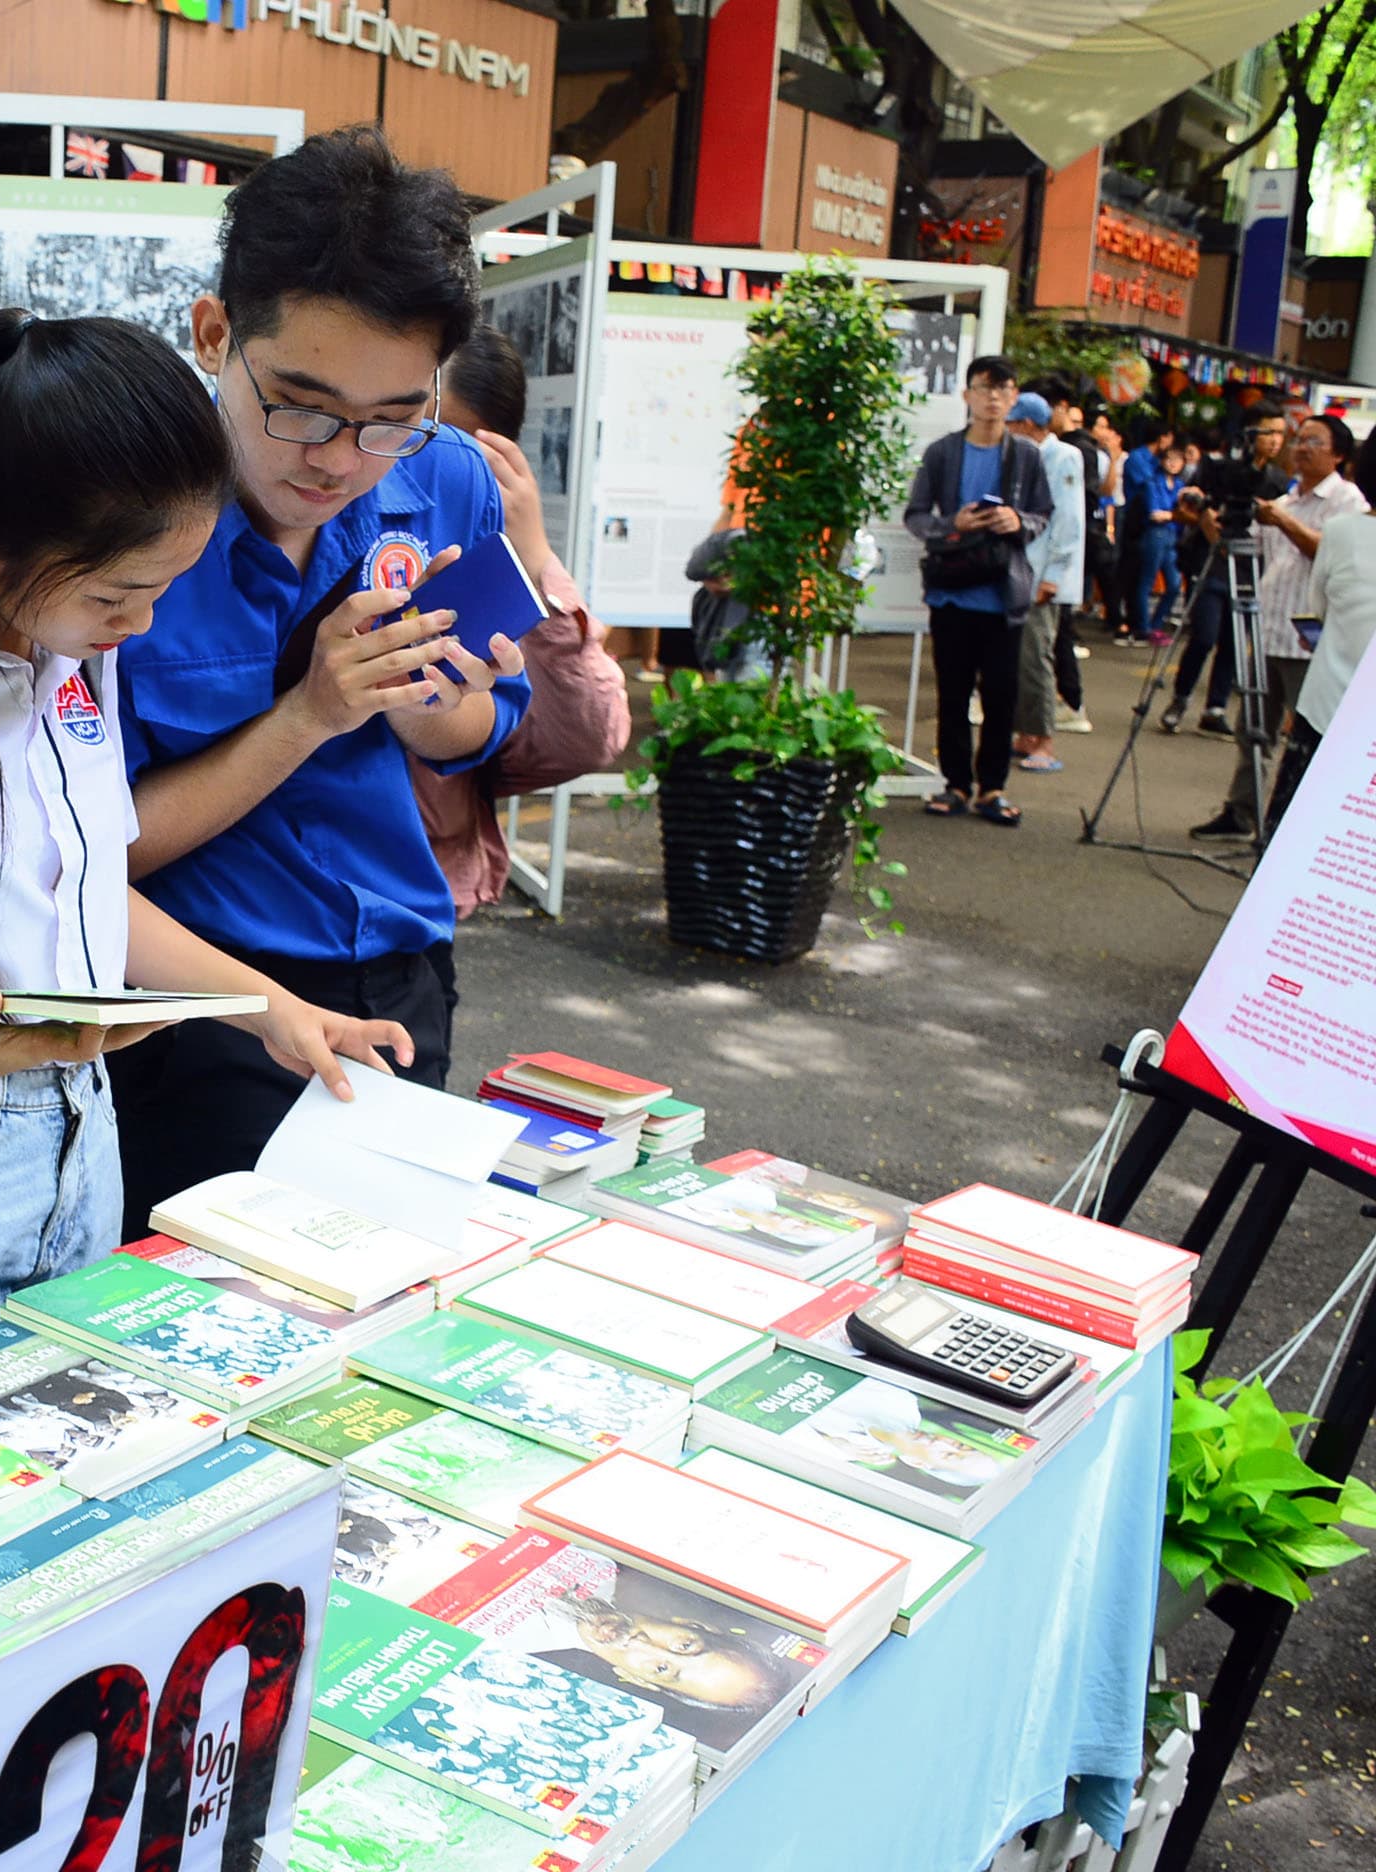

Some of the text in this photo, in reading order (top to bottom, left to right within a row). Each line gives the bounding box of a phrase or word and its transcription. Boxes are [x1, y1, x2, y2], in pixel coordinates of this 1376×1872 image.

[446, 38, 531, 96] NAM
[145, 1281, 187, 1304] THANH
[111, 1289, 205, 1333] LỜI BÁC DẠY
[350, 1397, 381, 1411] TÂY
[803, 1386, 836, 1404] BÁC
[330, 1407, 352, 1420] DU
[343, 1408, 413, 1444] BÁC HỒ
[376, 1626, 431, 1664] THANH
[414, 1639, 457, 1668] LỜI
[341, 1658, 388, 1691] THIẾU
[383, 1660, 432, 1693] BÁC
[315, 1684, 352, 1709] NHI
[352, 1684, 401, 1719] DẠY
[188, 1786, 231, 1838] OFF
